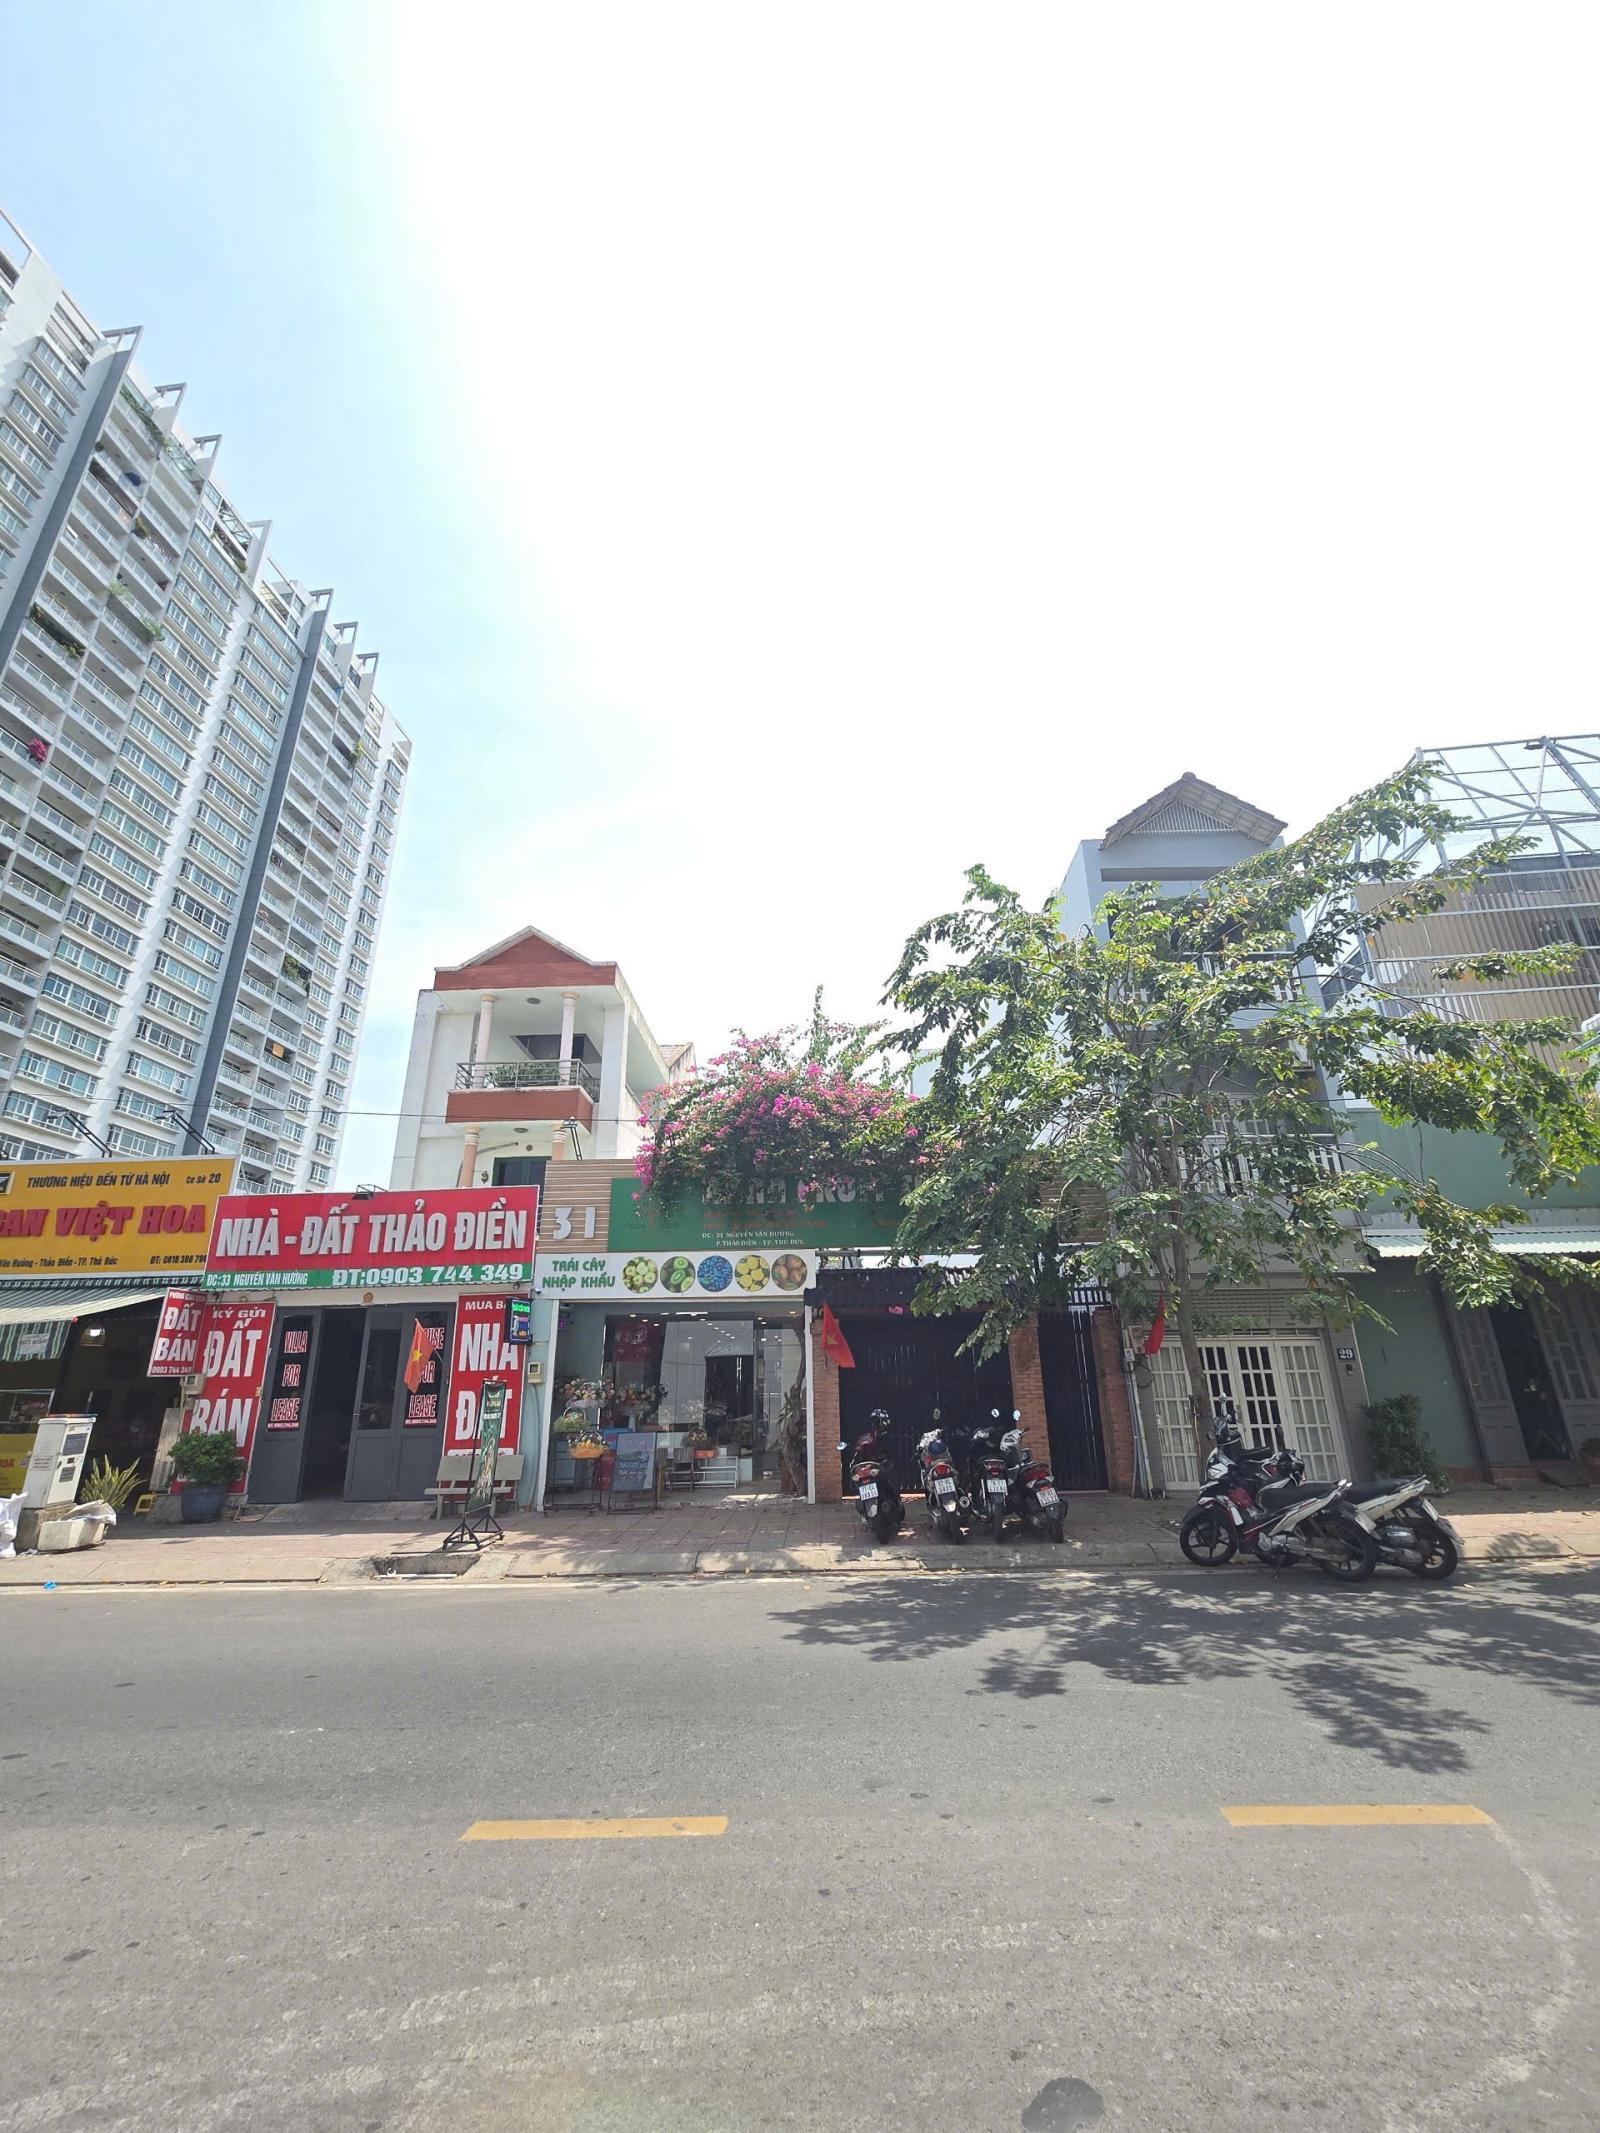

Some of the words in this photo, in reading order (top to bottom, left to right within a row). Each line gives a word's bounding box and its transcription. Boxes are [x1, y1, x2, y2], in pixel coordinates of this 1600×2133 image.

[27, 1175, 68, 1189] THƯƠNG
[69, 1173, 94, 1189] HIỆU
[95, 1171, 118, 1186] ĐẾN
[135, 1172, 149, 1185] HÀ
[151, 1171, 171, 1187] NỘI
[208, 1172, 222, 1184] 20
[55, 1200, 135, 1242] VIỆT
[138, 1204, 206, 1235] HOA
[216, 1207, 280, 1257] NHÀ
[300, 1202, 361, 1255] ĐẤT
[368, 1198, 448, 1254] THẢO
[454, 1196, 528, 1251] ĐIỀN
[553, 1206, 597, 1240] 31
[430, 1265, 474, 1284] 744
[480, 1263, 524, 1282] 349
[551, 1256, 580, 1272] TRÁI
[582, 1256, 606, 1272] CÂY
[233, 1270, 265, 1286] NGUYỄN
[542, 1273, 577, 1292] NHẬP
[163, 1303, 202, 1332] ĐẤT
[212, 1305, 234, 1319] KÝ
[238, 1306, 267, 1319] GỬI
[465, 1300, 493, 1311] MUA
[154, 1333, 198, 1362] BÁN
[202, 1317, 263, 1379] ĐẤT
[284, 1330, 308, 1354] VILLA
[426, 1327, 445, 1350] USE
[1338, 1348, 1354, 1360] 29
[282, 1363, 301, 1387] FOR
[420, 1360, 436, 1384] OR
[190, 1388, 254, 1448] BÁN
[271, 1396, 301, 1422] LEASE
[408, 1393, 438, 1419] LEASE
[455, 1374, 513, 1441] ĐT
